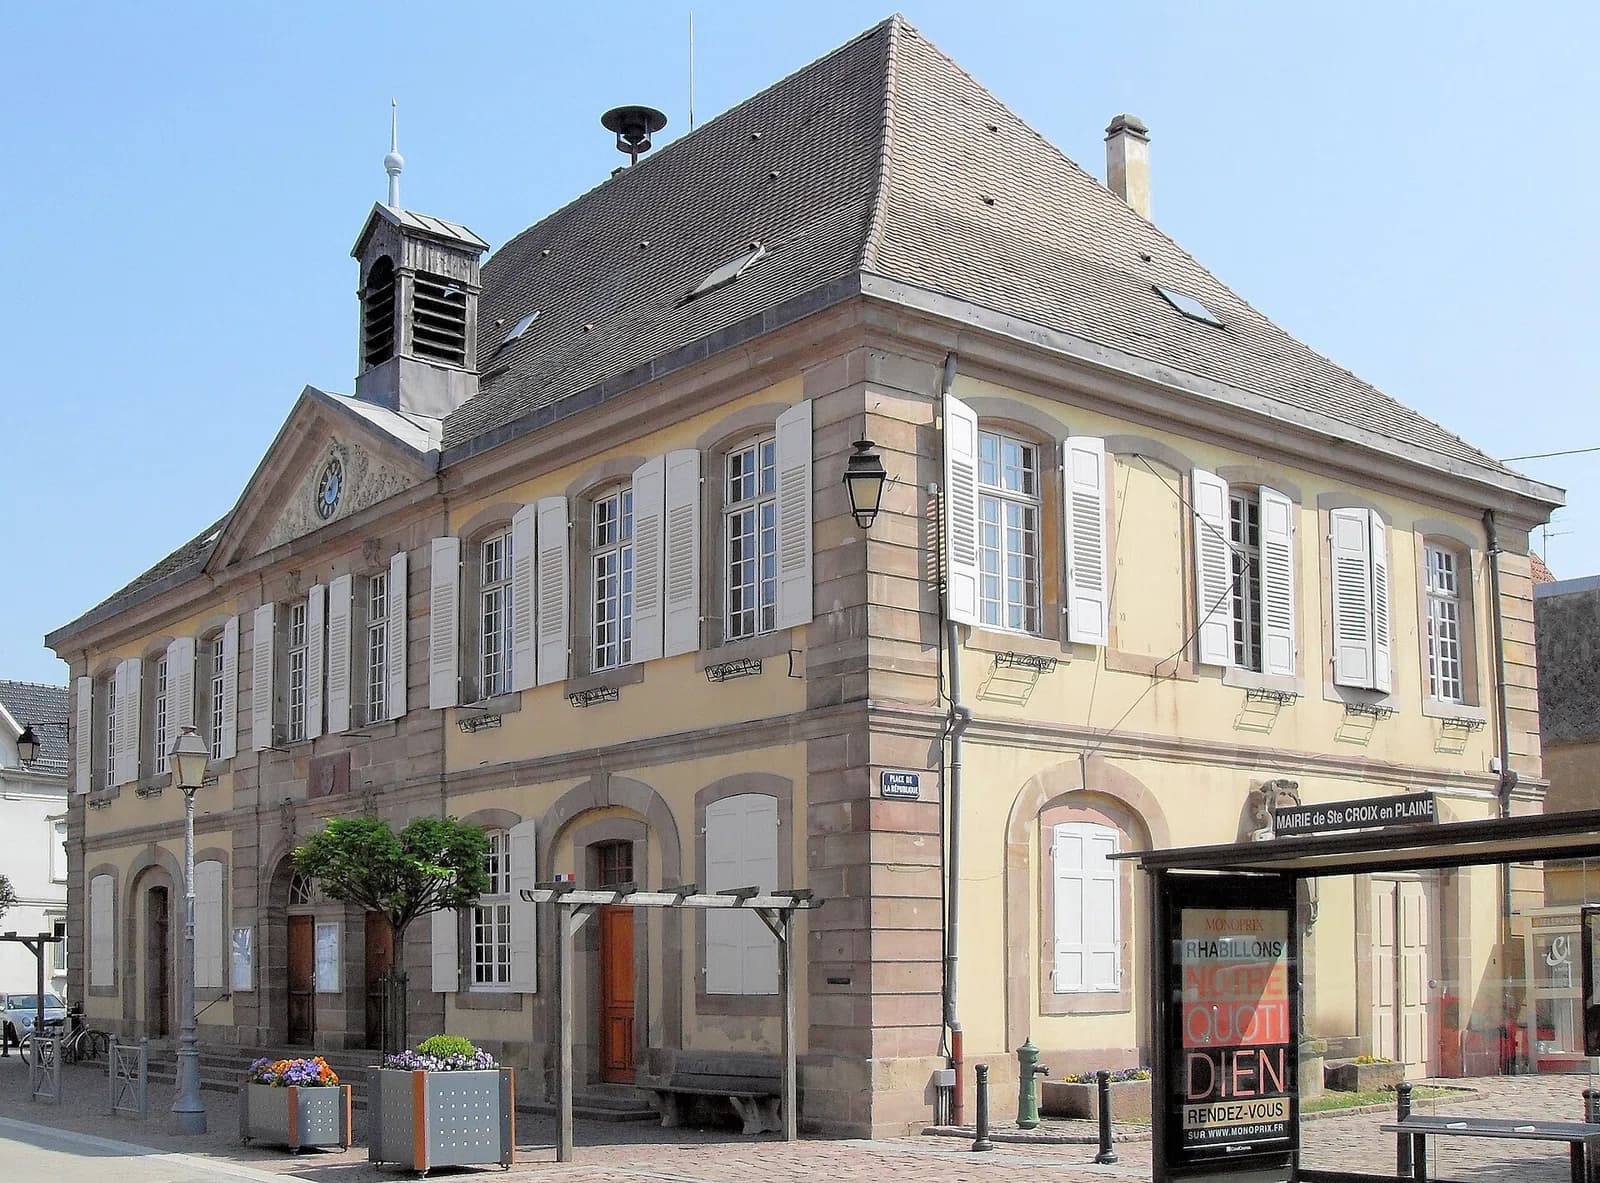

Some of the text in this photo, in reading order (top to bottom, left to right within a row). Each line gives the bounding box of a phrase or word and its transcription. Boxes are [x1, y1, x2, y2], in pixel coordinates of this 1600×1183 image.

[890, 774, 912, 783] PLACE DE
[891, 784, 918, 794] RÉPUBLIQUE
[1276, 800, 1433, 829] MAIRIE de Ste CROIX en PLAINE
[1206, 918, 1264, 931] MONOPRIX
[1187, 941, 1282, 958] RHABILLONS
[1186, 963, 1284, 997] NOTRE
[1187, 1004, 1285, 1043] QUOTI
[1187, 1048, 1284, 1100] DIEN
[1188, 1103, 1283, 1124] RENDEZ-VOUS
[1188, 1123, 1284, 1140] SUR WWW.MONOPRIX.FR
